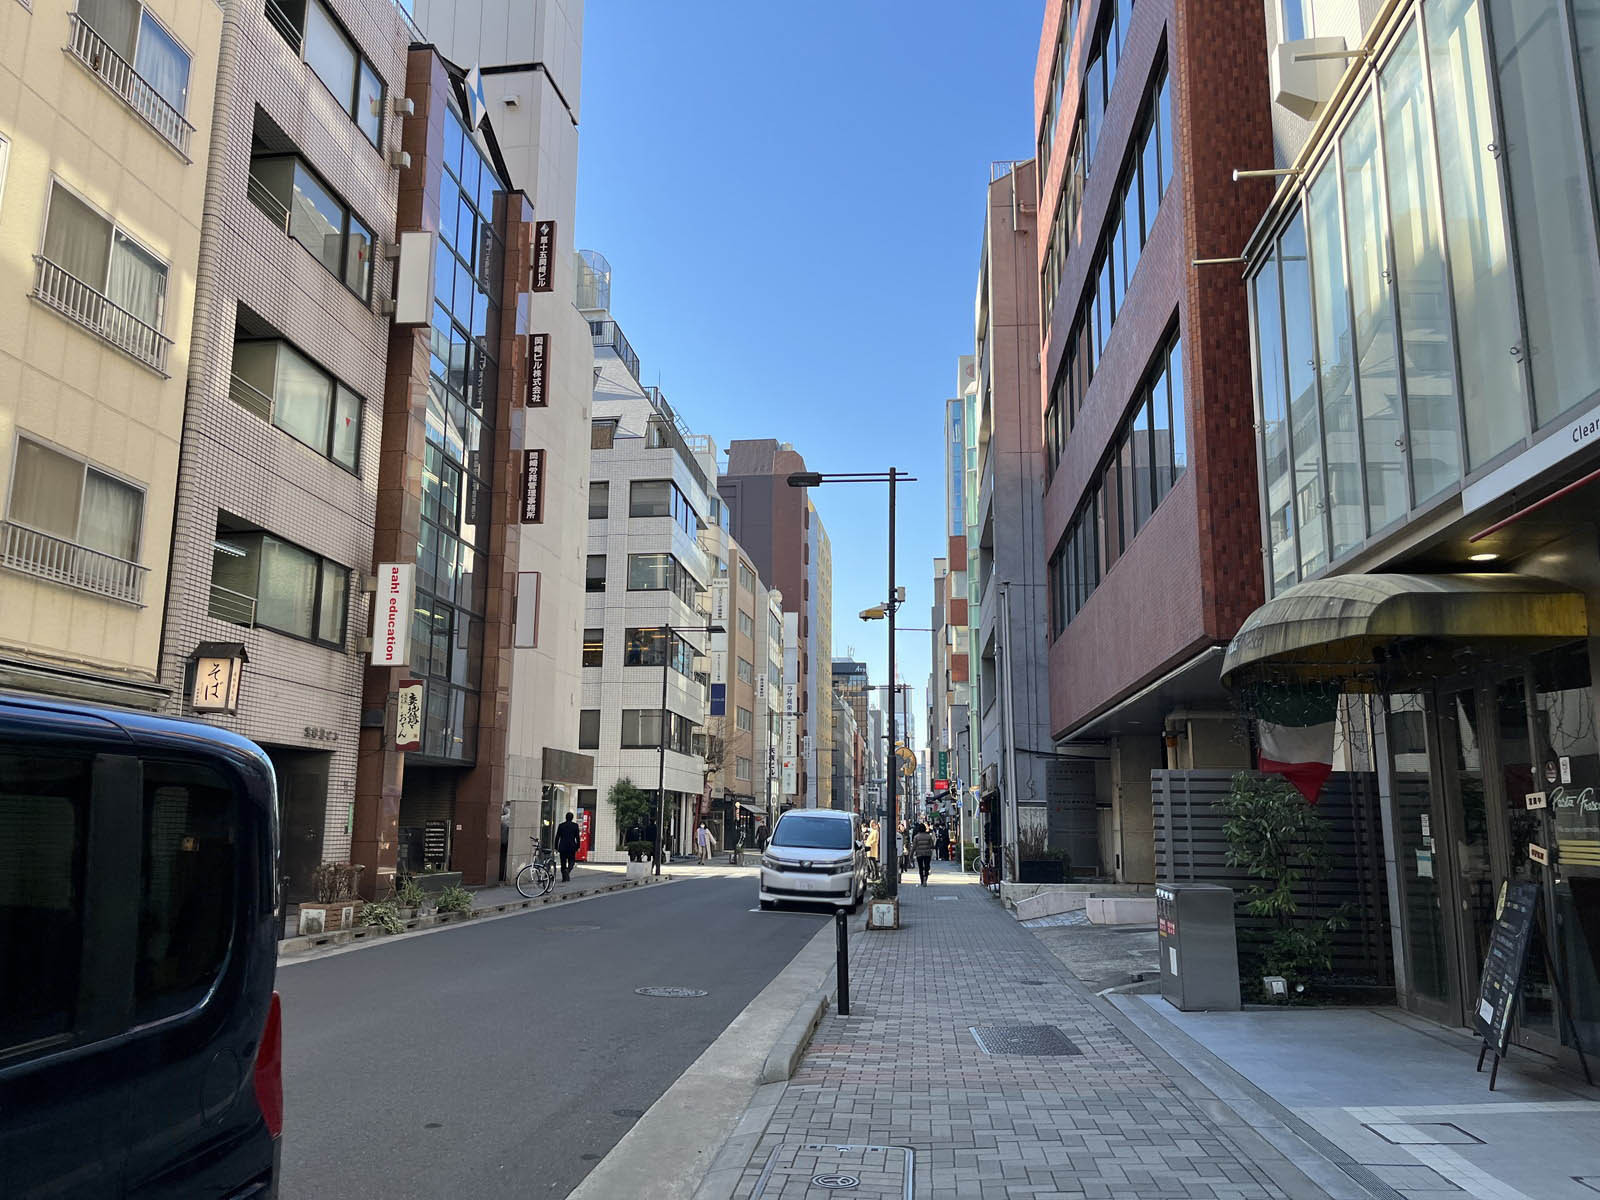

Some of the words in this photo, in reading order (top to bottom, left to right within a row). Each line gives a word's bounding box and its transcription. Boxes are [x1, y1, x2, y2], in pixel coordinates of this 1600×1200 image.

[537, 236, 549, 288] 第十五岡崎ビル
[532, 336, 544, 403] 岡崎ビル株式会社
[1572, 418, 1600, 443] Clear
[391, 567, 400, 594] aah!
[385, 597, 398, 661] education
[204, 662, 224, 701] そば
[1549, 786, 1577, 812] Pasta
